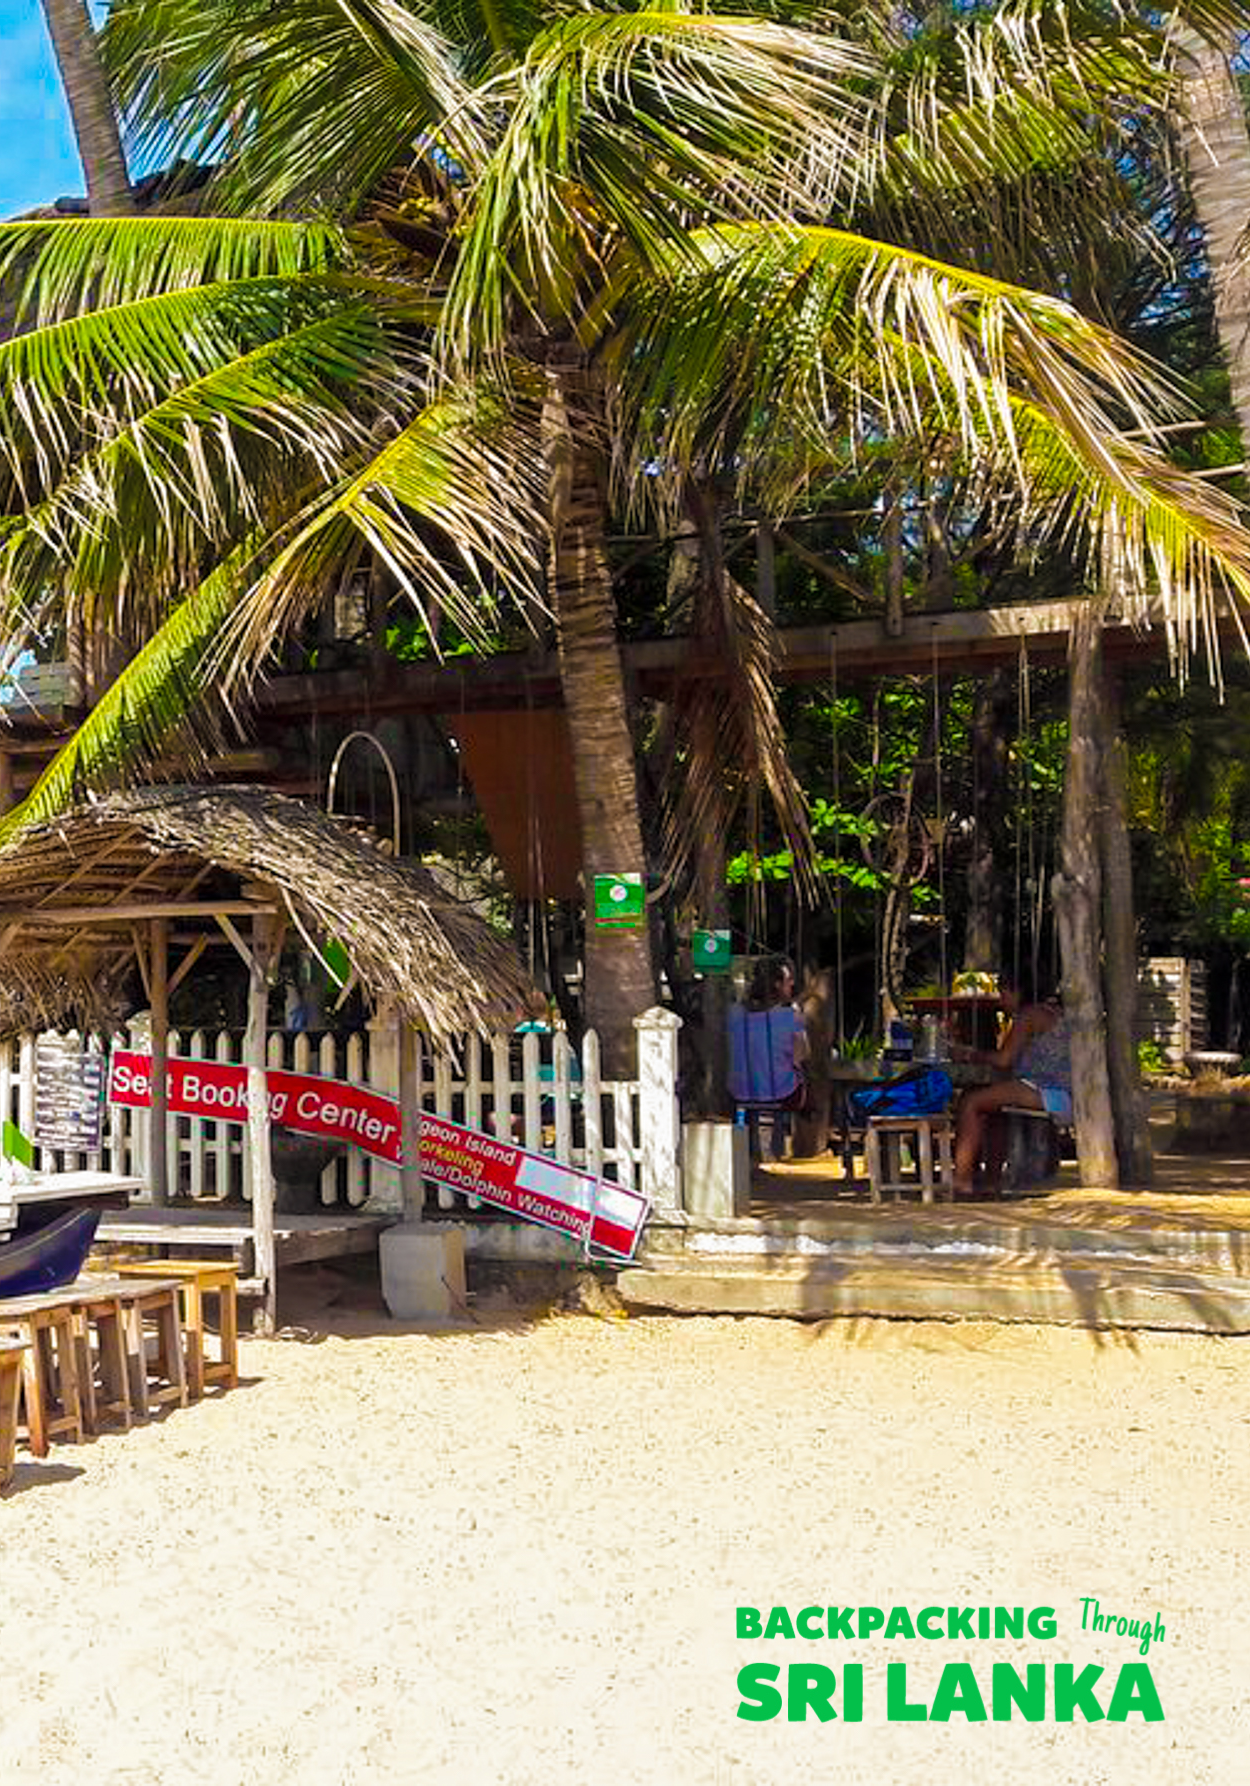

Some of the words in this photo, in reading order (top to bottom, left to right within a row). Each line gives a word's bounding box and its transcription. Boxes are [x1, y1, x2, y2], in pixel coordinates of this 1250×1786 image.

[113, 1065, 173, 1100] Set
[182, 1074, 288, 1120] Bookg
[296, 1090, 397, 1144] Center
[418, 1140, 485, 1178] orkeling
[419, 1120, 461, 1146] geon
[465, 1135, 517, 1167] Island
[396, 1145, 512, 1203] ale/Dolphin
[517, 1192, 590, 1238] Watching
